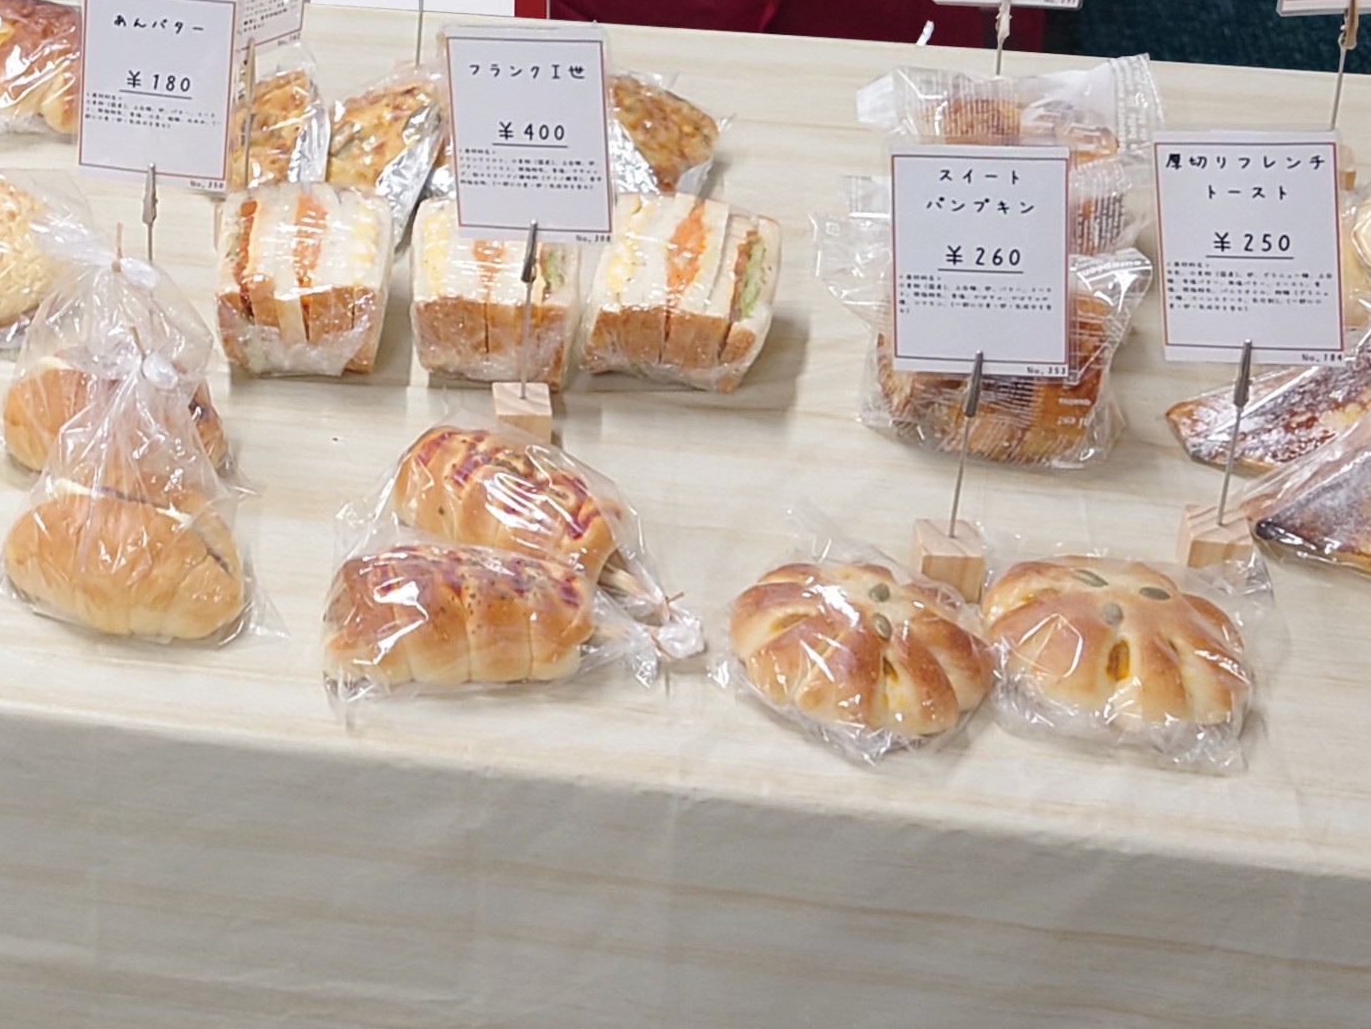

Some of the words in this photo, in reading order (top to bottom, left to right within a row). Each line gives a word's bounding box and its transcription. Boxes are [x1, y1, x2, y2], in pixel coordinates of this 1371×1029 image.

[113, 14, 205, 35] あんバター
[126, 70, 191, 93] ¥180
[498, 121, 566, 141] ¥400
[1165, 152, 1326, 170] 厚切りフレンチ
[940, 168, 1020, 186] スイート
[1207, 184, 1288, 201] トースト
[926, 196, 1035, 215] パンプキン
[1213, 231, 1291, 253] ¥250
[945, 244, 1021, 267] ¥260
